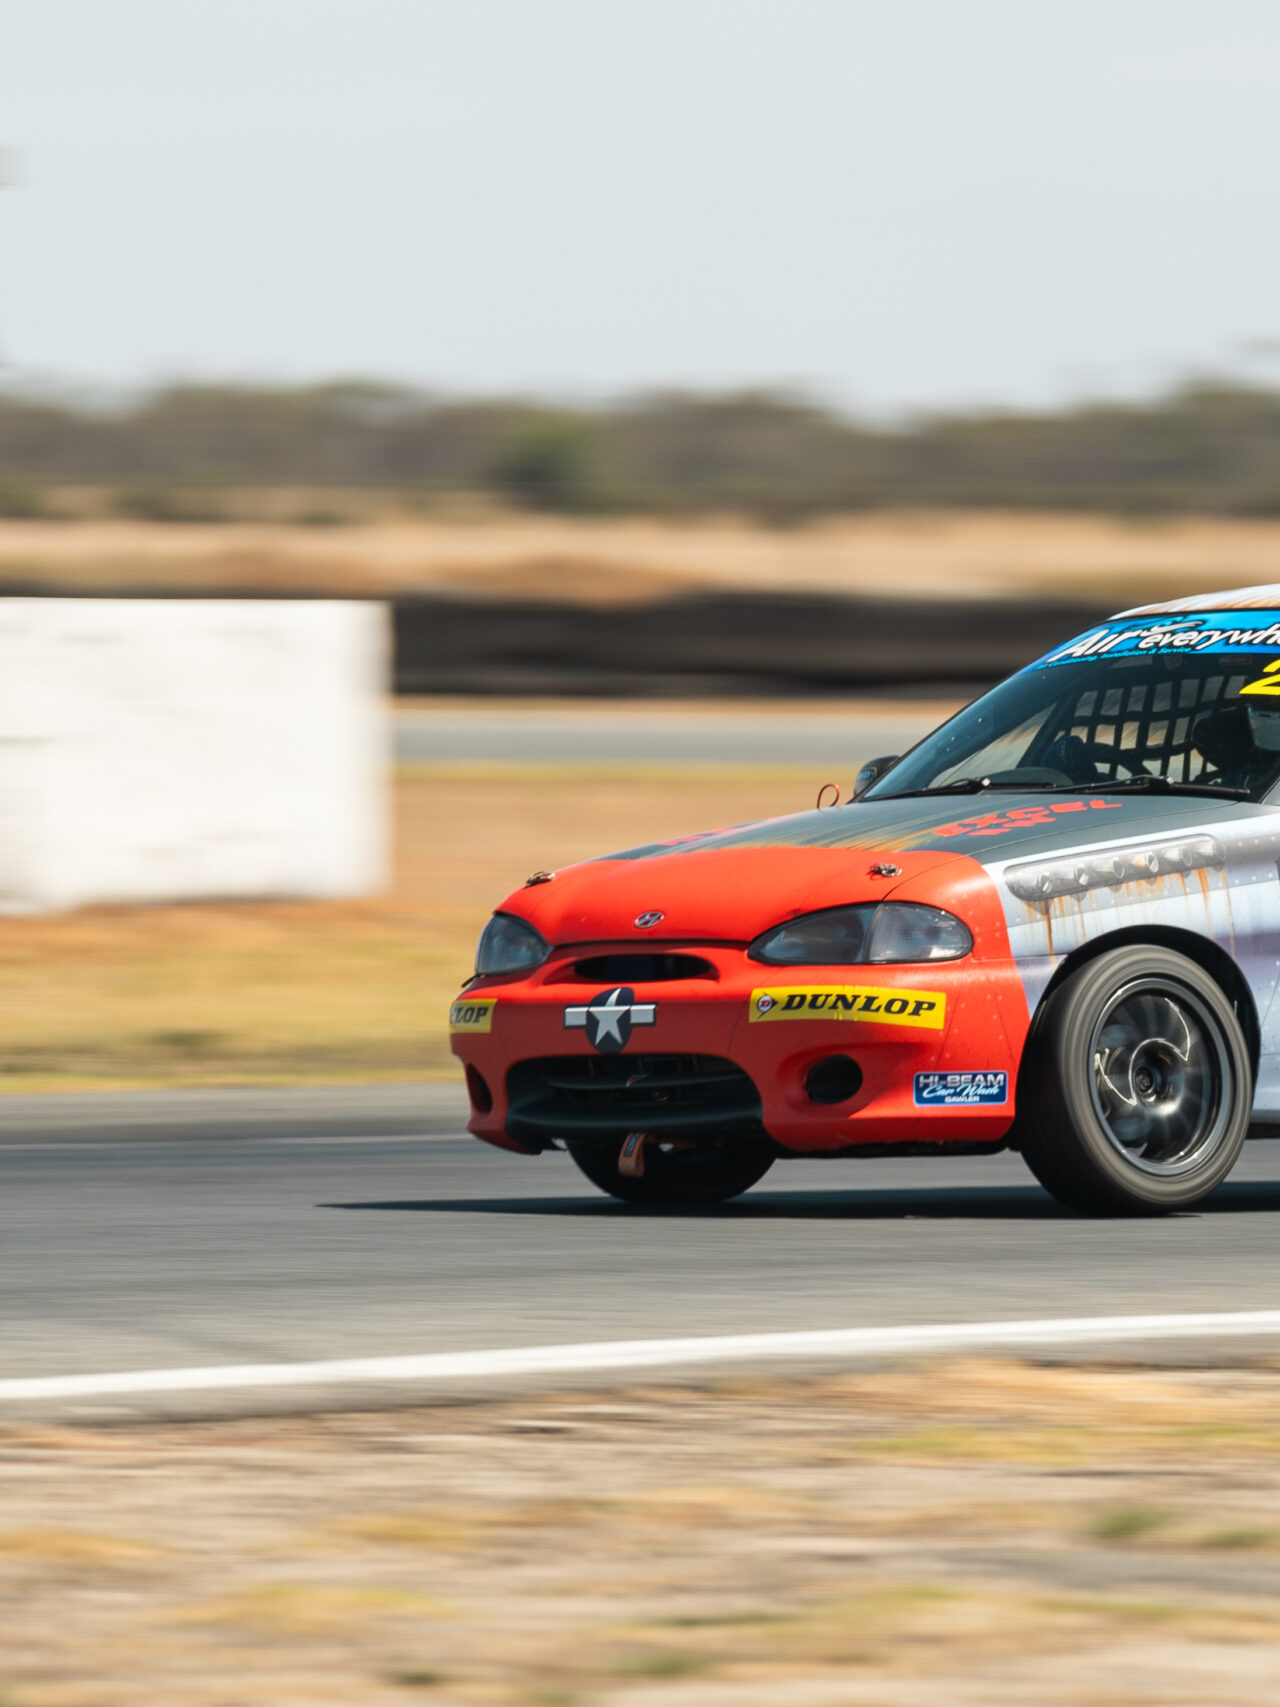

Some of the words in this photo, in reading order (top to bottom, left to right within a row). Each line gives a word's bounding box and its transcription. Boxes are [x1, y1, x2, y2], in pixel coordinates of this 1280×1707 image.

[1046, 628, 1143, 664] Air
[1157, 645, 1192, 655] Service
[931, 799, 1123, 838] EXCEL
[780, 994, 936, 1017] DUNLOP
[919, 1073, 1005, 1089] HI-BEAM
[922, 1084, 955, 1098] Car
[956, 1083, 1000, 1097] Wash
